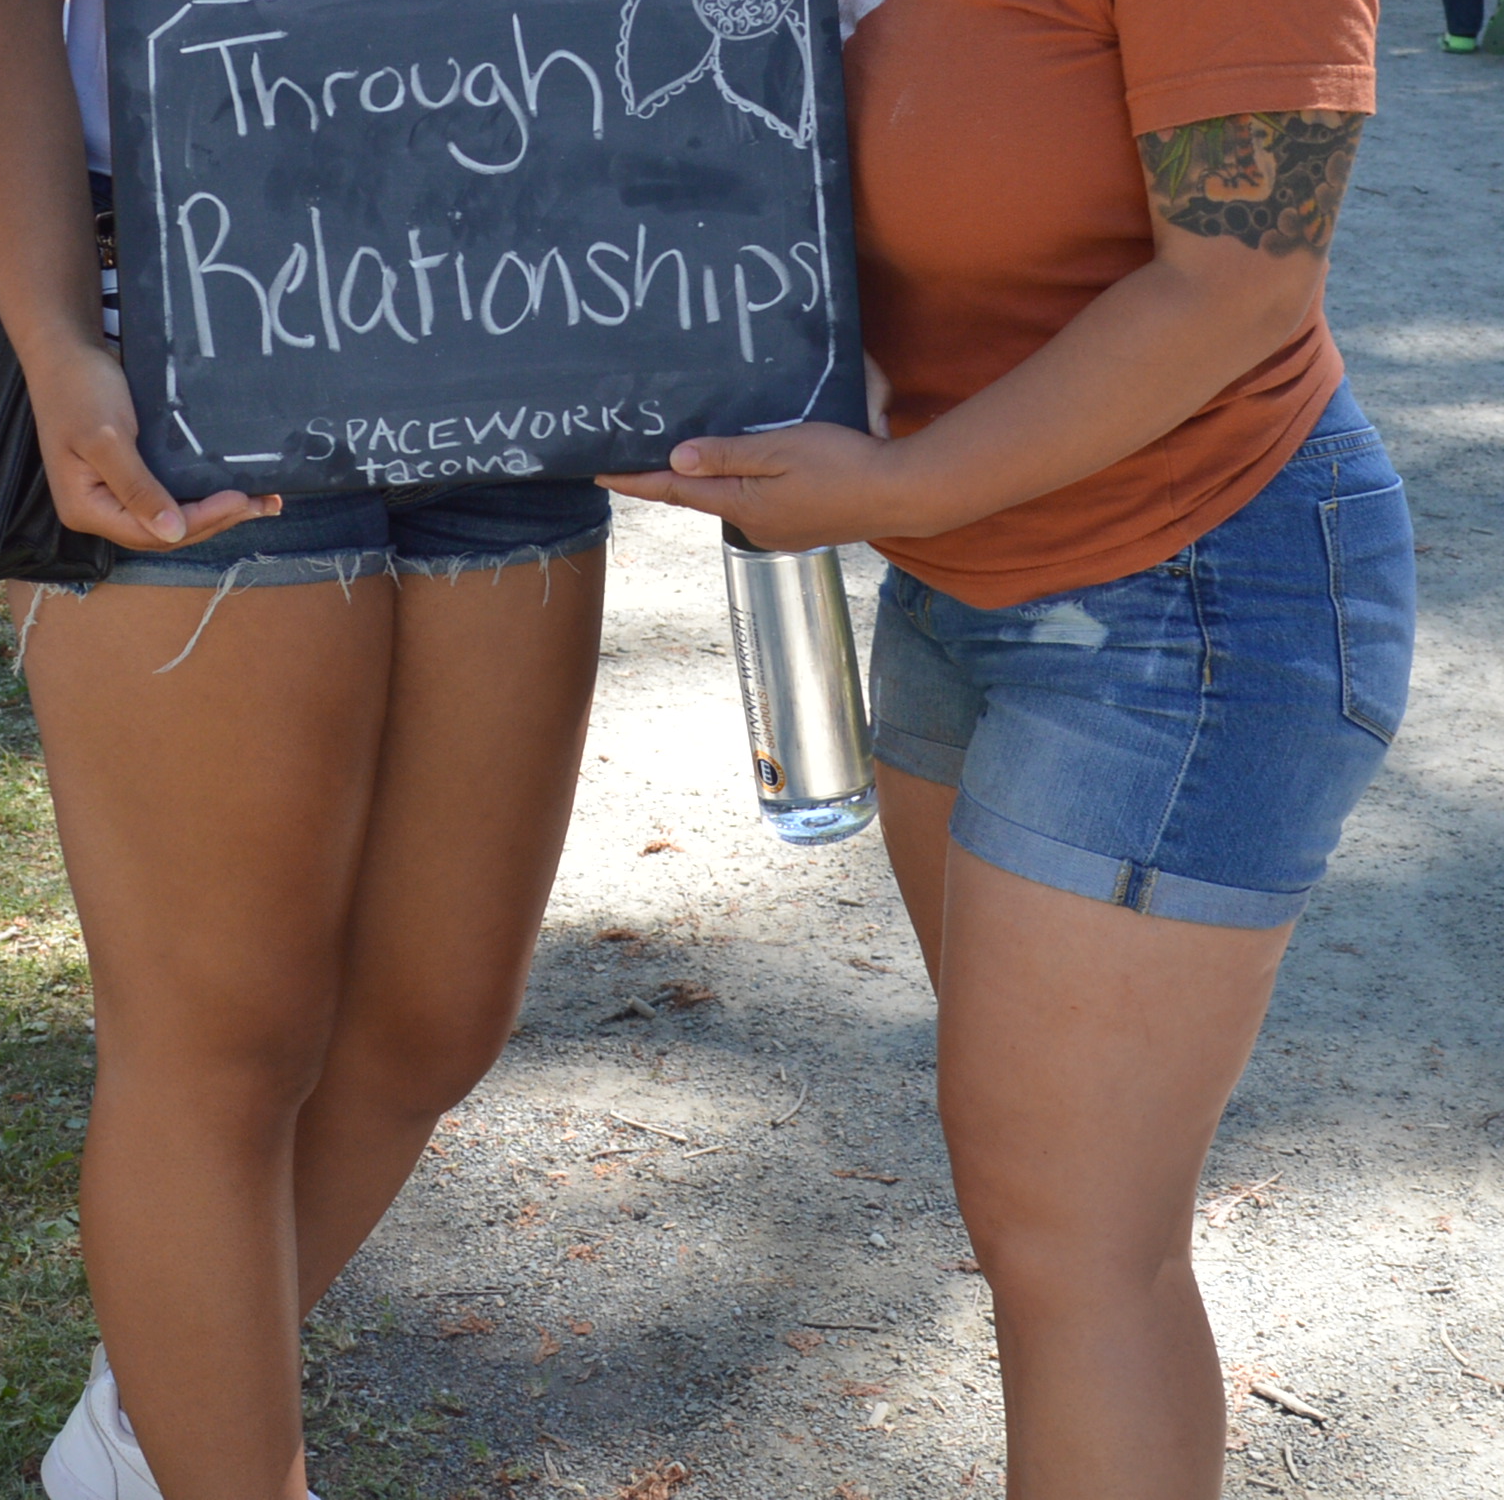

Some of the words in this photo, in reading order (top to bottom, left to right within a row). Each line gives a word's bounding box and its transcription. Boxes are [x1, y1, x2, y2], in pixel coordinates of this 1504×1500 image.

[180, 13, 603, 175] Through
[178, 192, 822, 363] Relationships
[305, 398, 667, 462] SPACEWORKS
[745, 684, 763, 744] ANNIE
[756, 690, 776, 749] SCHOOLS
